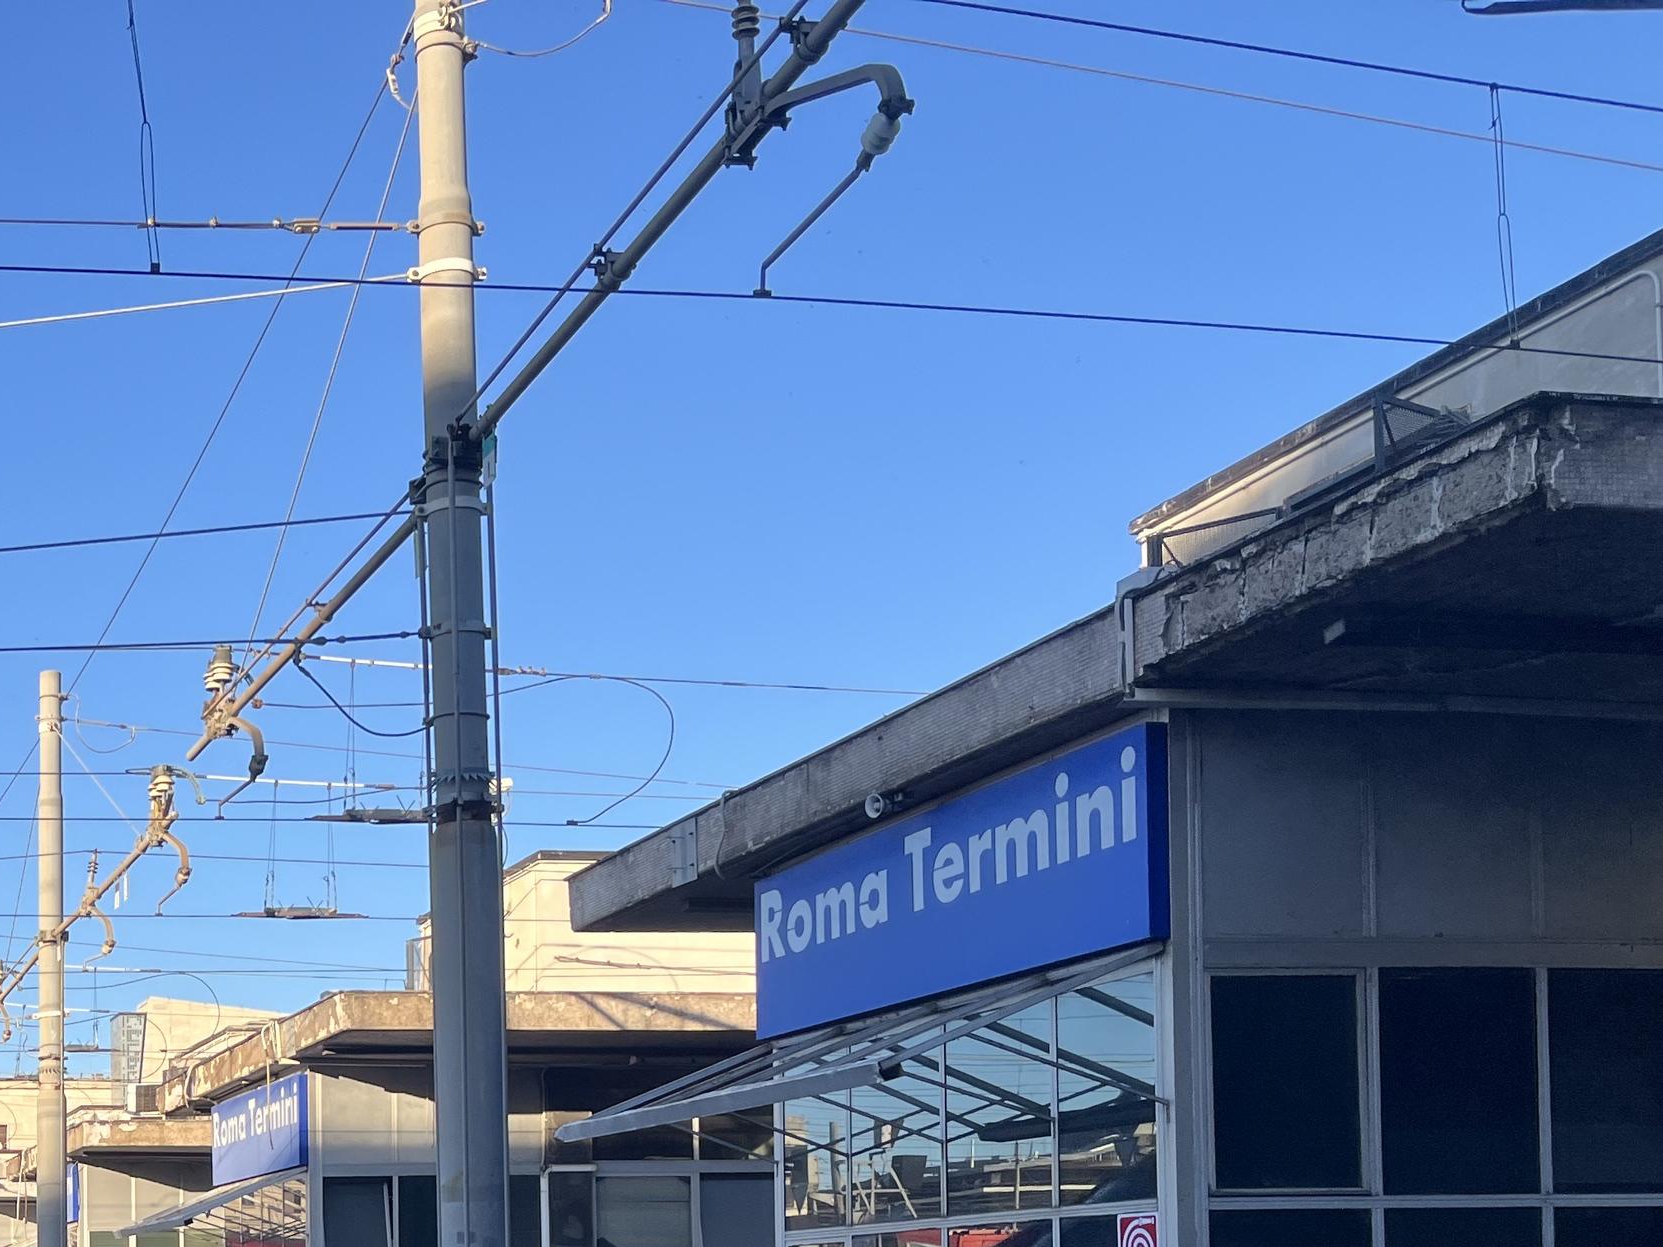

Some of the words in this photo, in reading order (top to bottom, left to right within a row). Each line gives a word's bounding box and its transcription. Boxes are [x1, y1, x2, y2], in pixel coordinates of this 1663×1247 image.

[760, 868, 889, 963] Roma
[904, 745, 1138, 913] Termini
[213, 1112, 246, 1149] Roma
